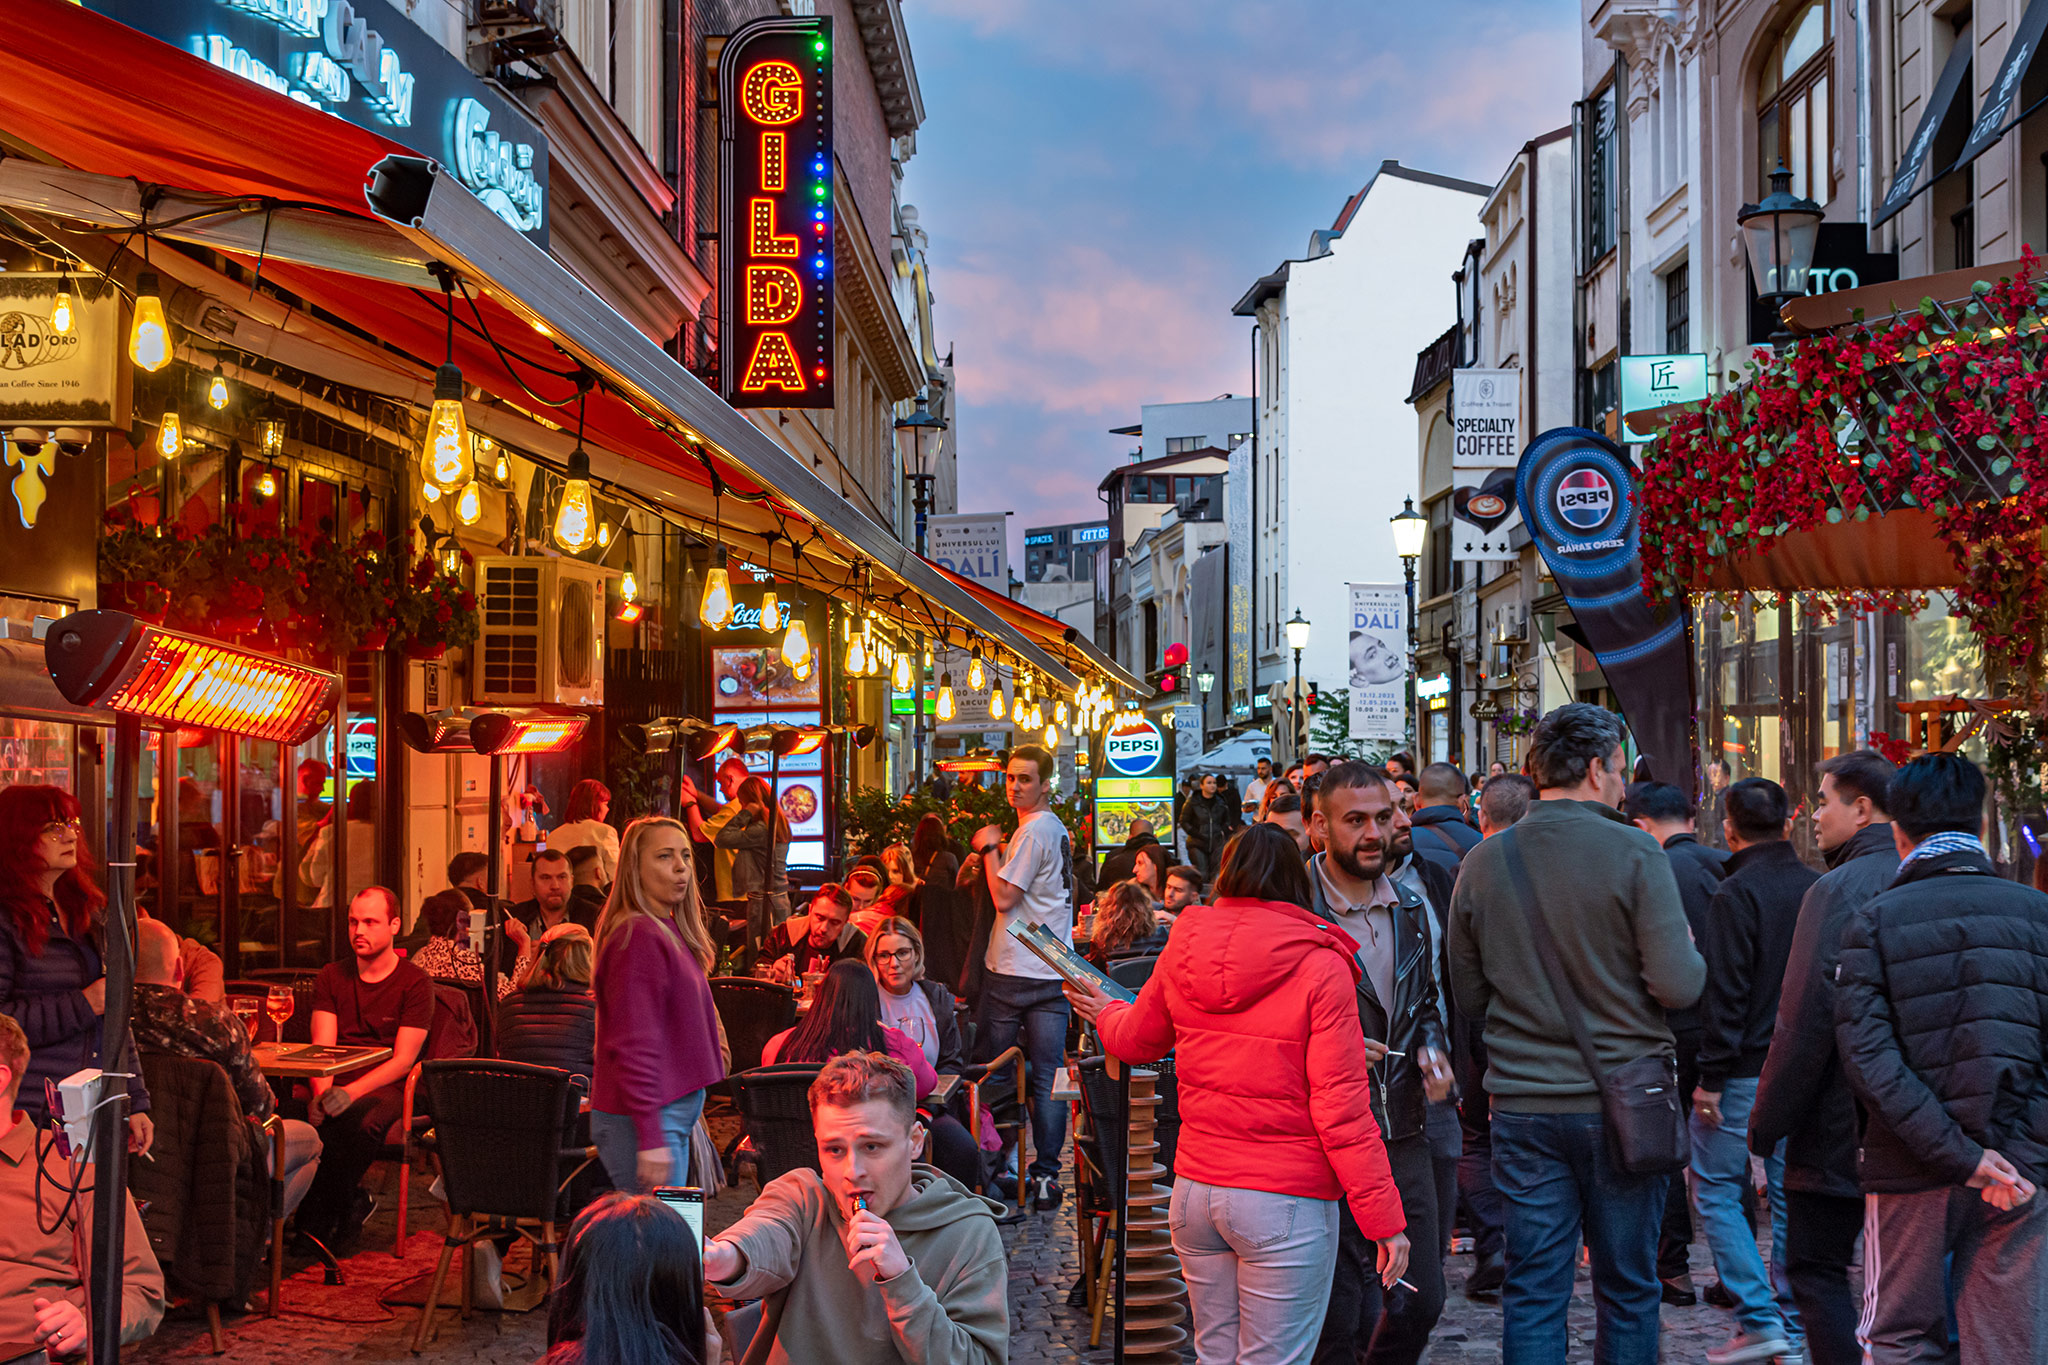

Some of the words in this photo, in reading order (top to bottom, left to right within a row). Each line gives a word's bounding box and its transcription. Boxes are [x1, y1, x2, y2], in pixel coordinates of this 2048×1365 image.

[742, 61, 805, 391] GILDA
[1650, 360, 1680, 391] 匠
[11, 380, 35, 388] Coffee
[37, 380, 58, 388] Since
[61, 380, 80, 388] 1946
[1461, 400, 1484, 408] Coffee
[1457, 418, 1515, 433] SPECIALTY
[1456, 435, 1515, 456] COFFEE
[935, 540, 983, 548] UNIVERSUL
[936, 548, 991, 556] SALVADOR
[936, 550, 1000, 578] DALÍ
[1354, 609, 1400, 629] DALÍ
[1109, 739, 1159, 752] PEPSI
